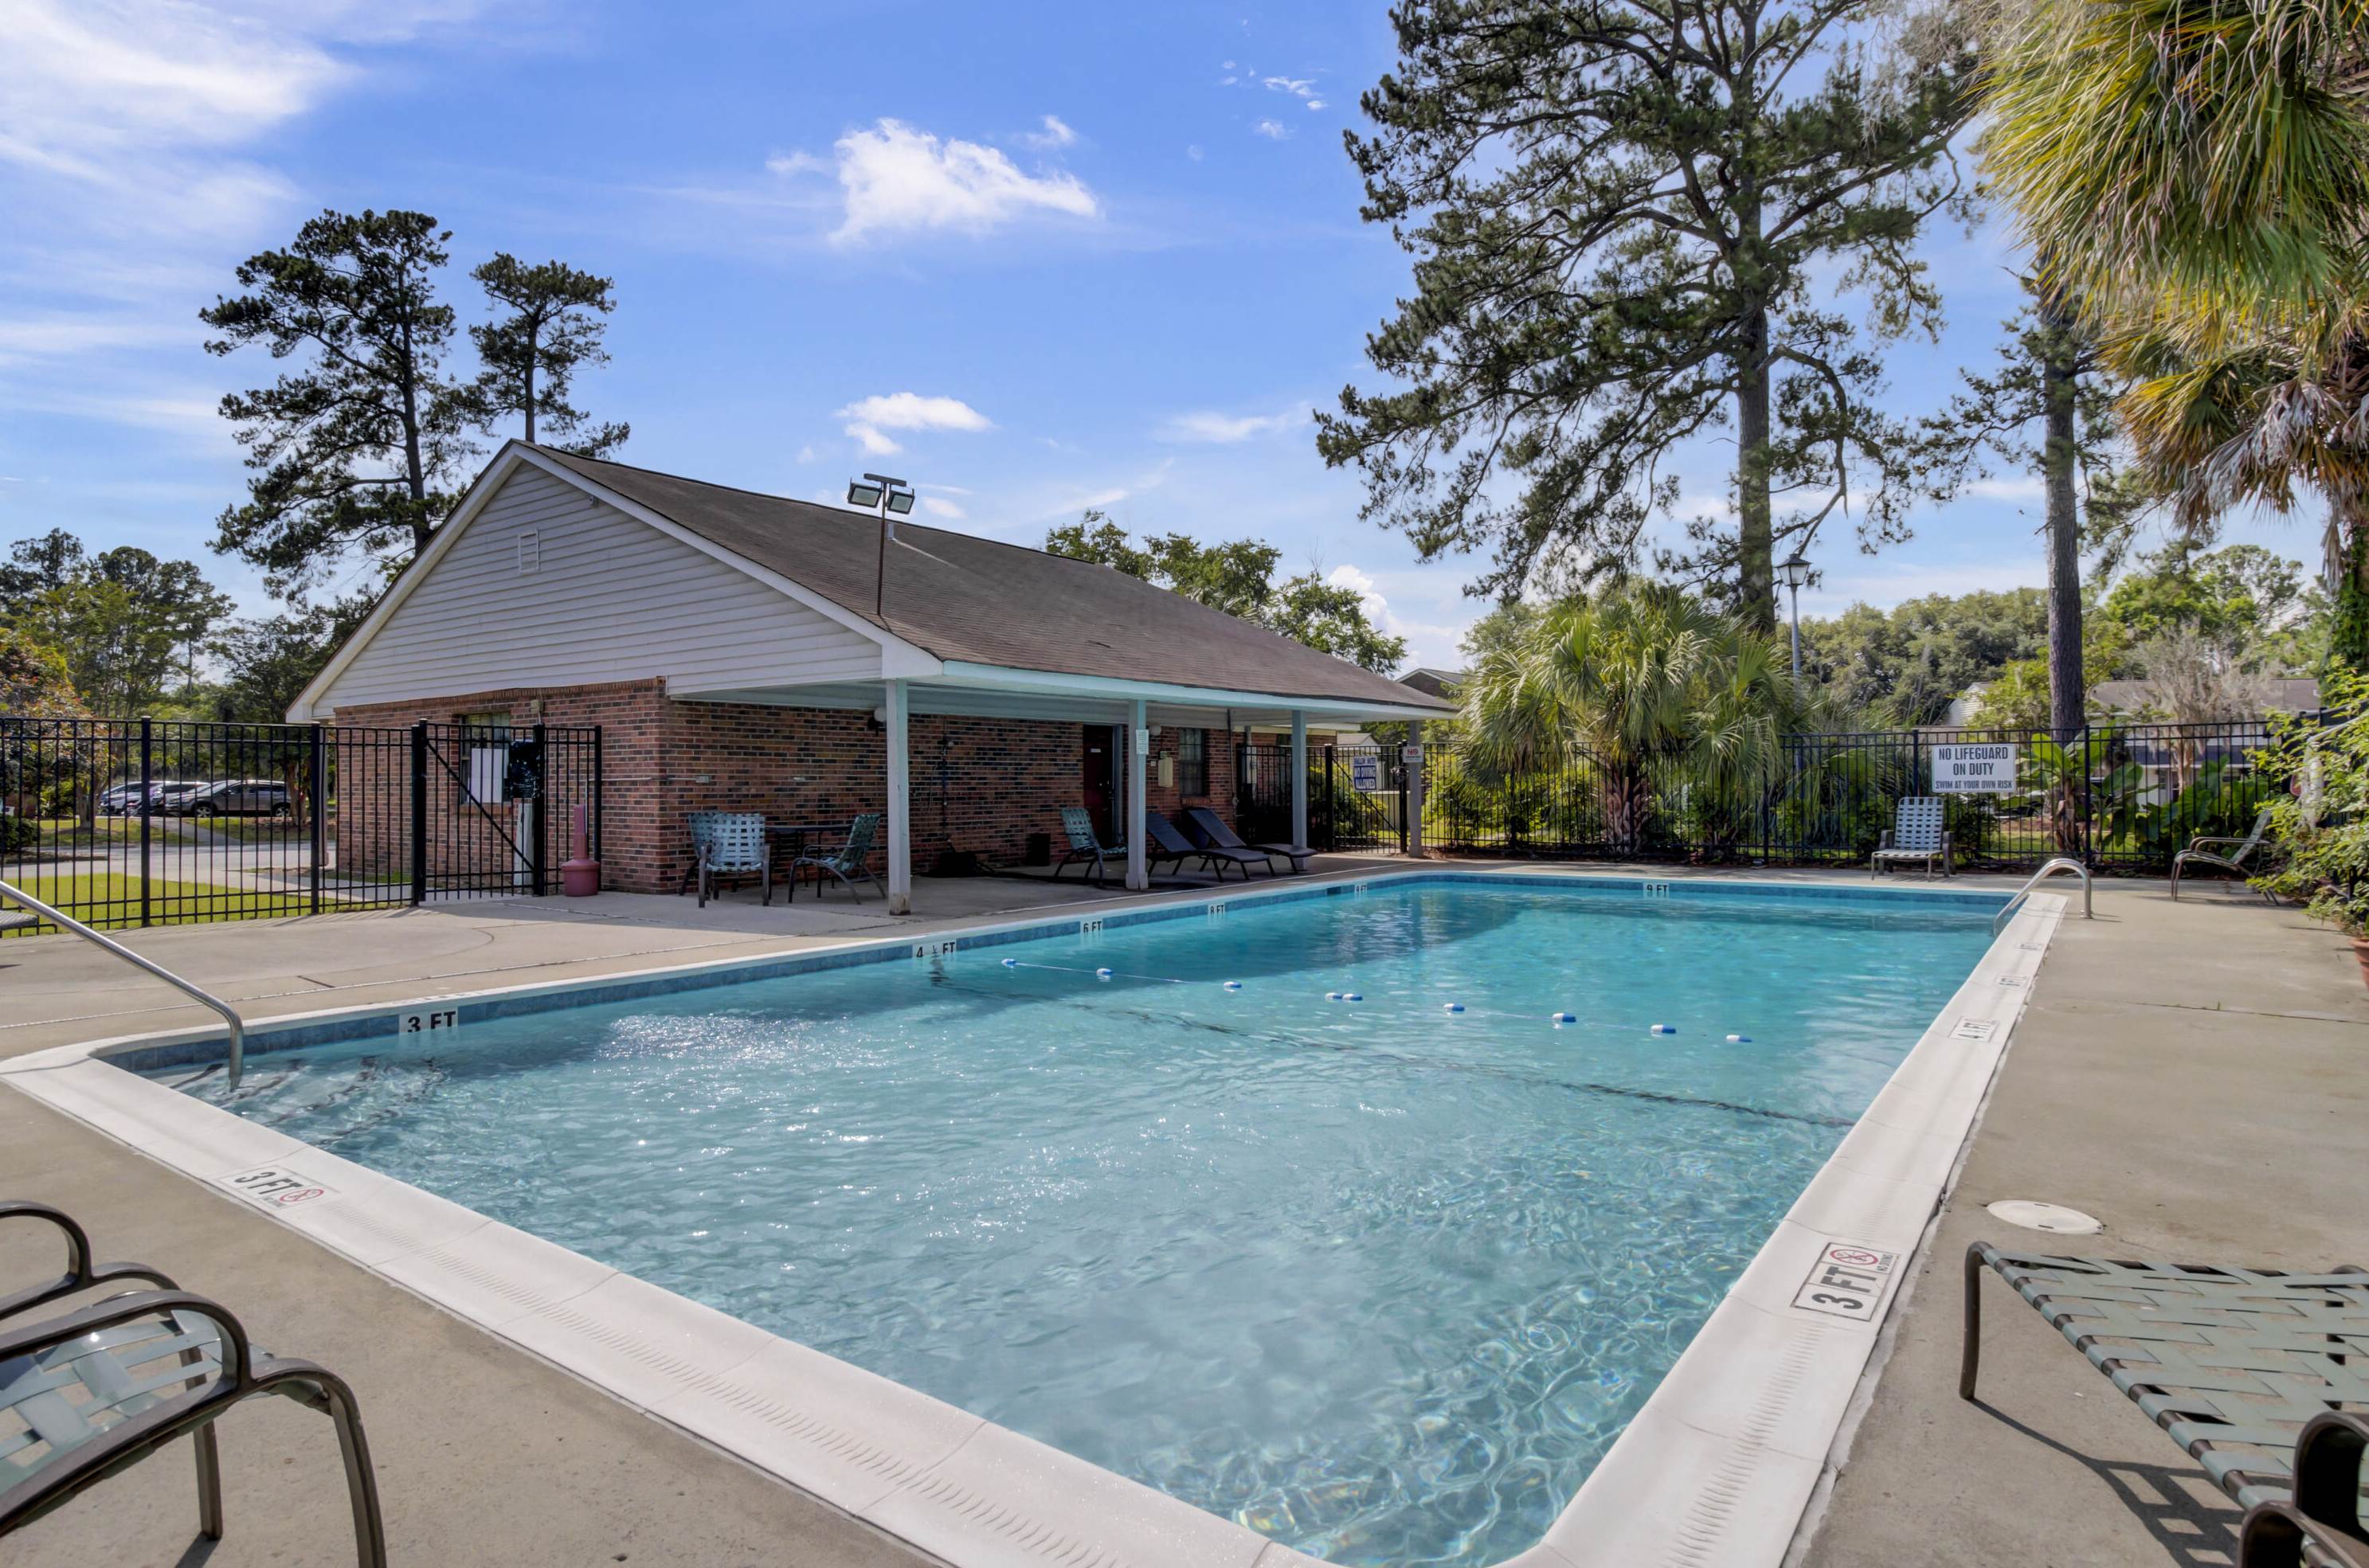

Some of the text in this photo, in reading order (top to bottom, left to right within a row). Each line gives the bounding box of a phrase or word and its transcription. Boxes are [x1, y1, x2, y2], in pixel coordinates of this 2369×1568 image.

[1938, 747, 2008, 761] NO LIFEGUARD
[1953, 763, 1994, 776] ON DUTY
[1964, 780, 1979, 789] YOUR
[1981, 780, 1995, 789] OWN
[1997, 780, 2012, 789] RISK
[1657, 884, 1668, 893] FT
[1216, 905, 1224, 914] FT
[1091, 921, 1102, 932] FT
[916, 946, 924, 958] 4
[942, 942, 955, 955] FT
[407, 1011, 456, 1033] 3 FT
[234, 1171, 303, 1195] 3 FT
[1811, 1265, 1877, 1310] 3 FT
